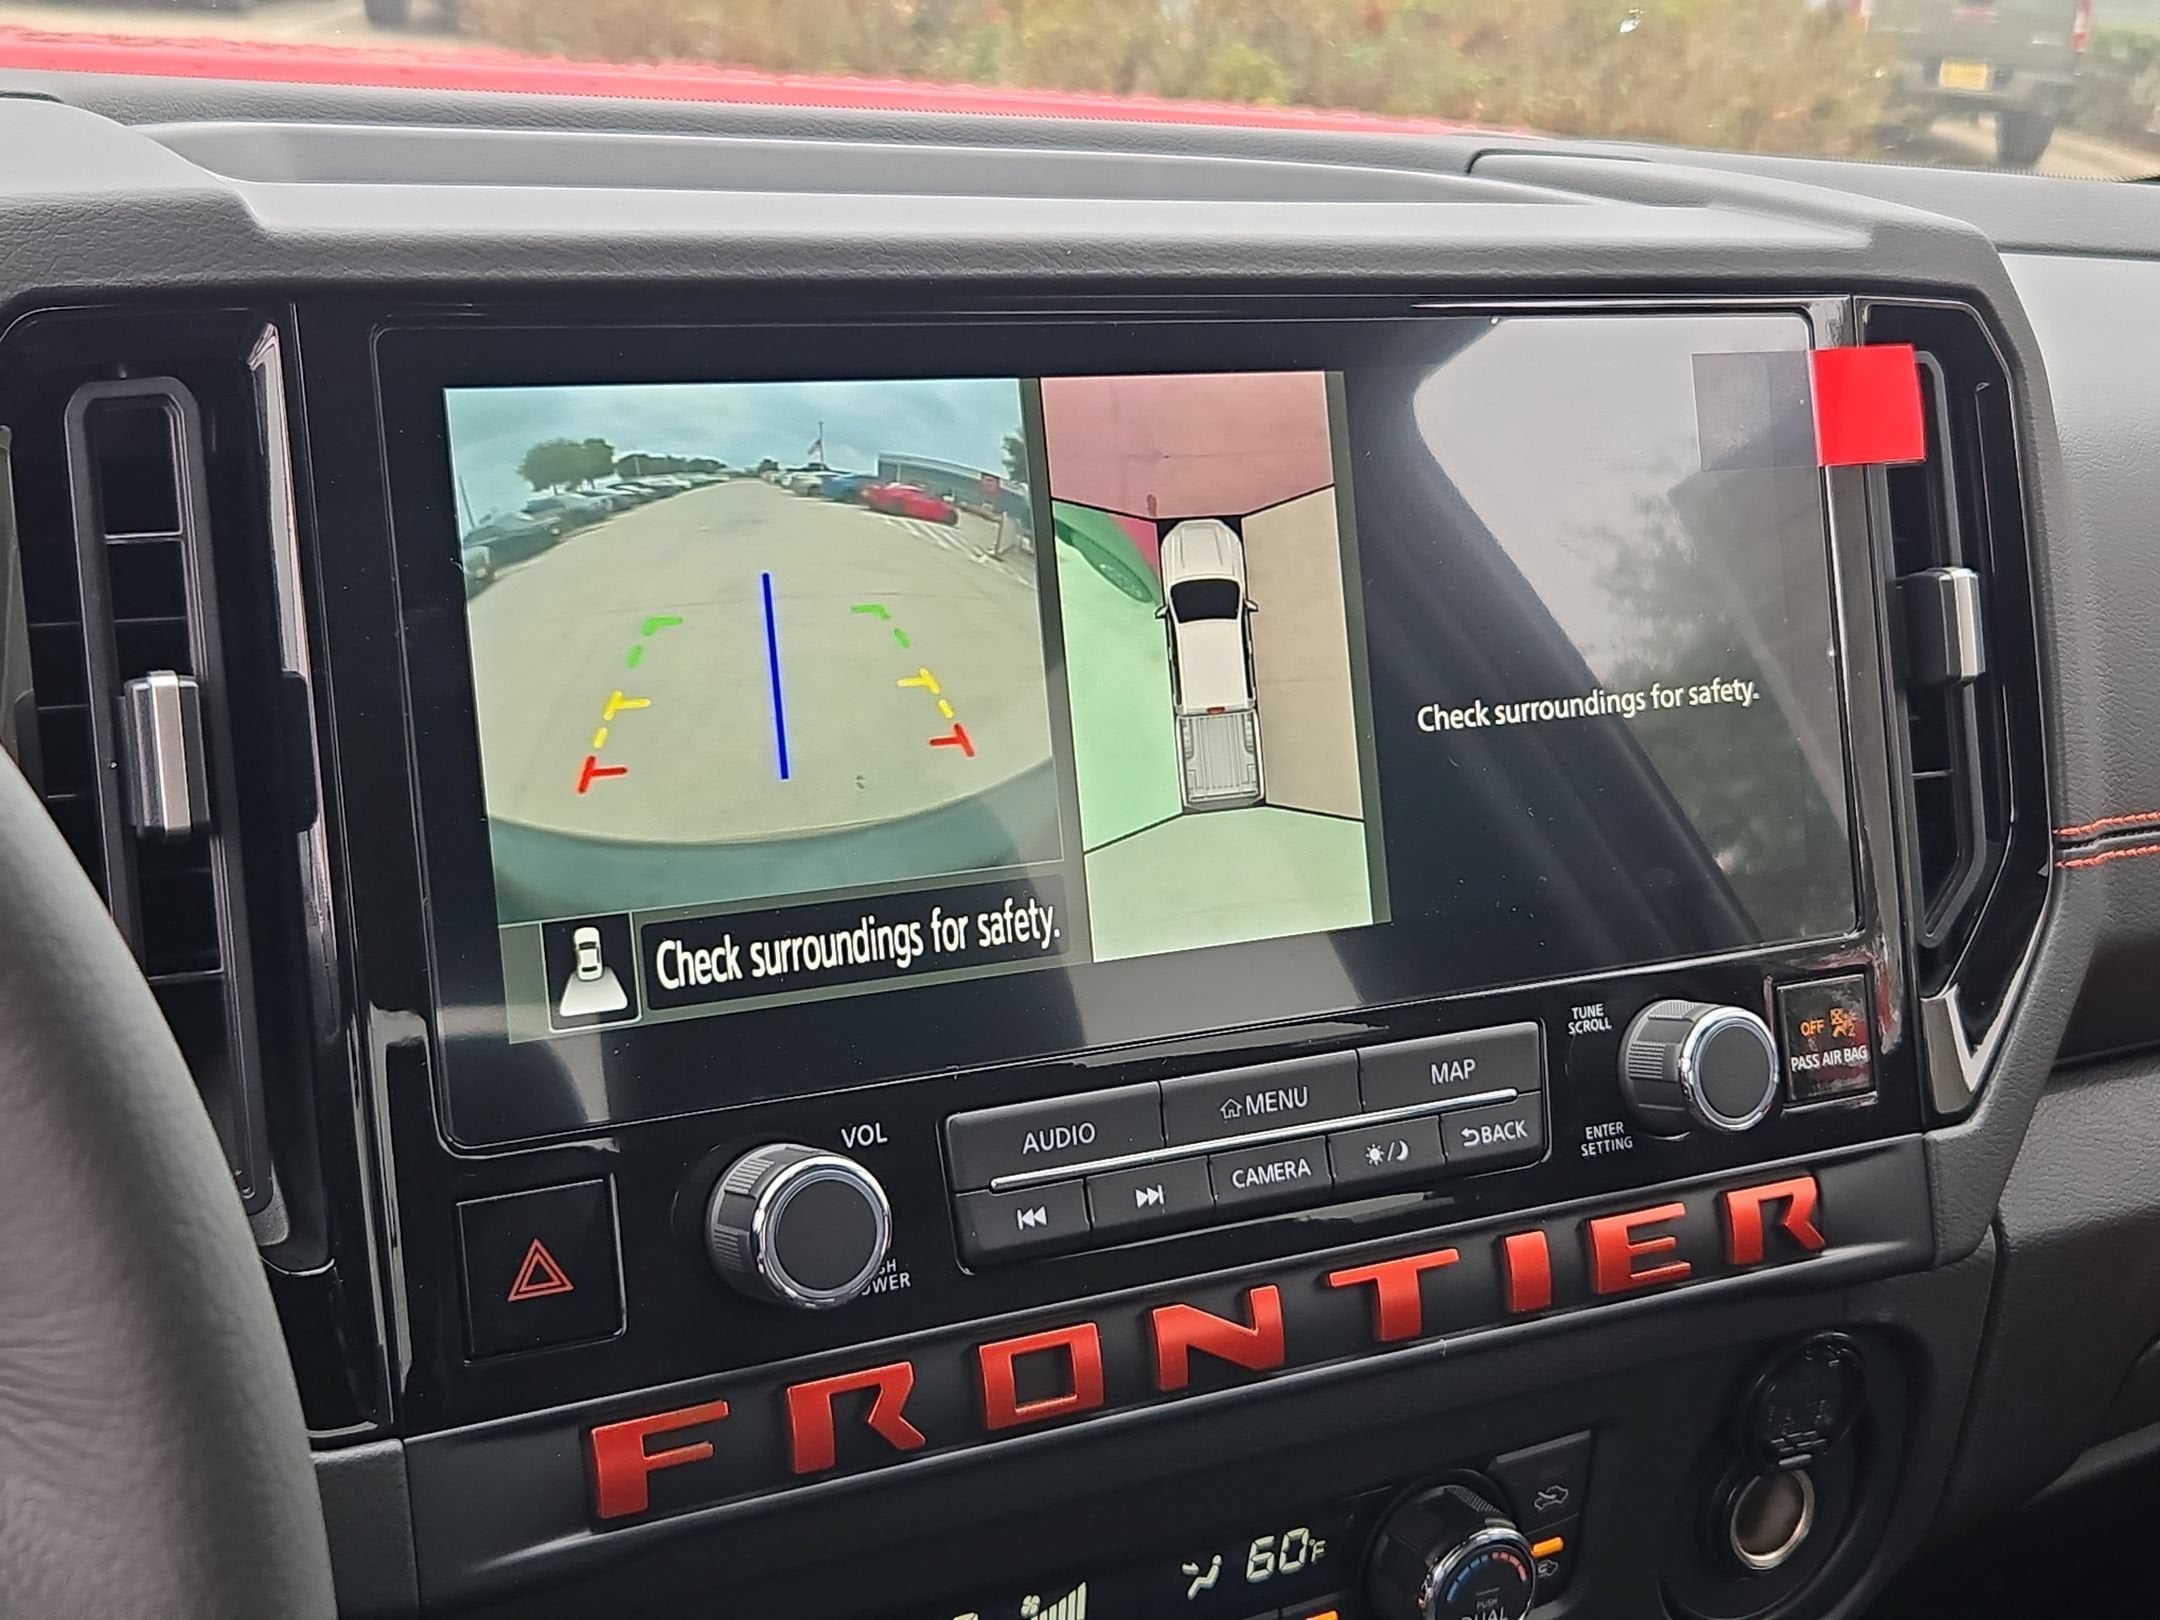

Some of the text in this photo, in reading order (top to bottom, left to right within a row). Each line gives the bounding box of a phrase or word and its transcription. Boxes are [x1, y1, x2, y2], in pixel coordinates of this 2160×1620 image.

[1417, 677, 1760, 732] Check surroundings for safety.
[656, 897, 1061, 990] Check surroundings for safety.
[1571, 1003, 1604, 1019] TUNE
[1567, 1017, 1613, 1035] SCROLL
[1800, 1019, 1825, 1037] OFF
[1430, 1058, 1477, 1084] MAP
[1791, 1044, 1868, 1072] PASS AIR BAG
[1243, 1086, 1310, 1116] MENU
[841, 1122, 888, 1149] VOL
[1021, 1121, 1097, 1154] AUDIO
[1480, 1119, 1529, 1145] BACK
[1585, 1121, 1625, 1140] ENTER
[1581, 1135, 1633, 1157] SETTING
[1231, 1157, 1312, 1189] CAMERA
[861, 1272, 911, 1296] WER
[591, 1175, 1826, 1520] FRONTIER
